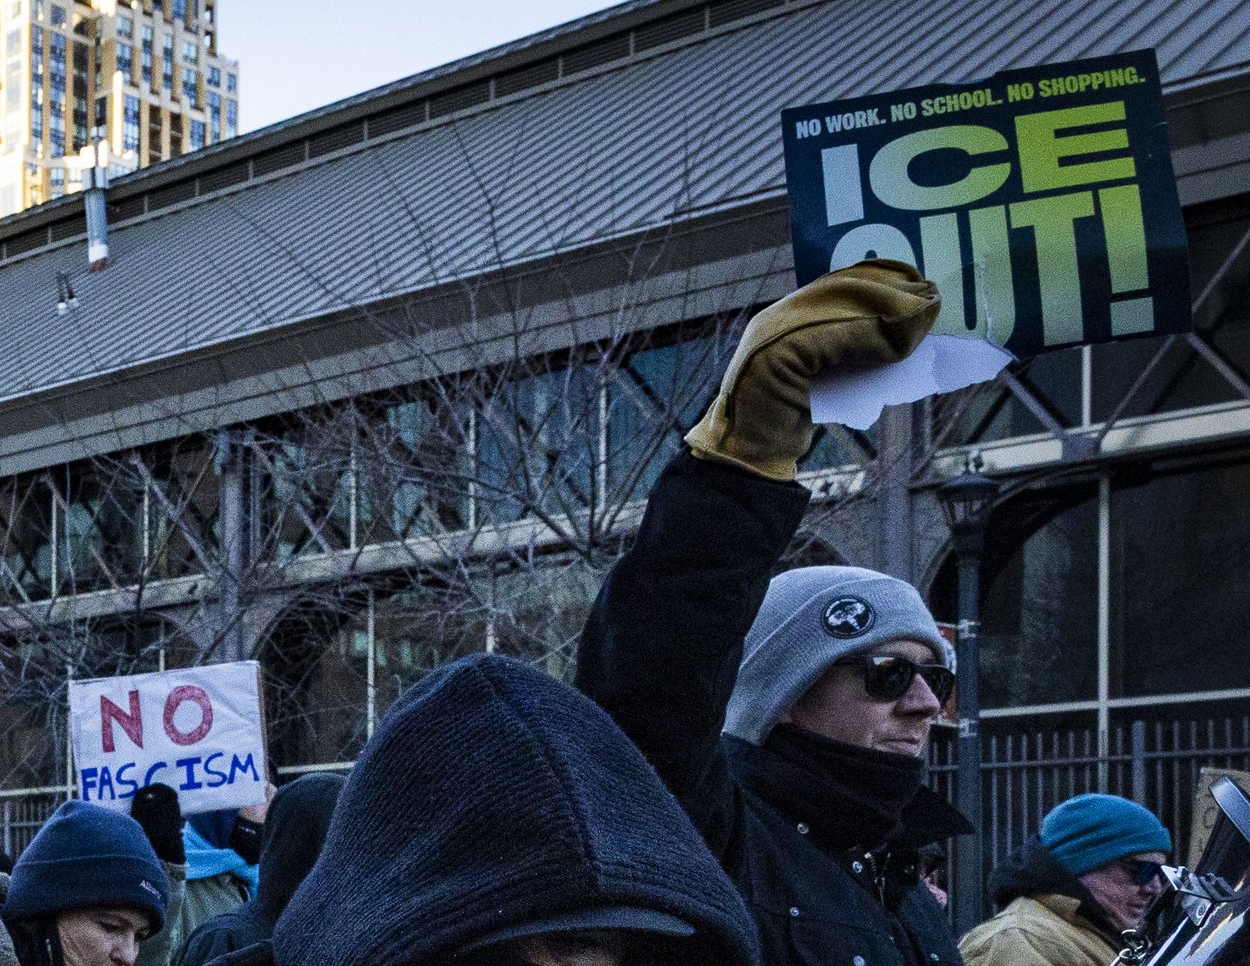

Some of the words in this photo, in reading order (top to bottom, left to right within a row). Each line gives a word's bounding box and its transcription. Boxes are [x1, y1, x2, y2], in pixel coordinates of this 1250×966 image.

[795, 118, 821, 139] NO
[825, 108, 887, 135] WORK.
[891, 101, 917, 124] NO
[922, 88, 1003, 117] SCHOOL.
[1007, 82, 1034, 102] NO
[1038, 66, 1146, 98] SHOPPING.
[821, 100, 1137, 227] ICE
[100, 685, 214, 753] NO
[80, 752, 260, 801] FASCISM
